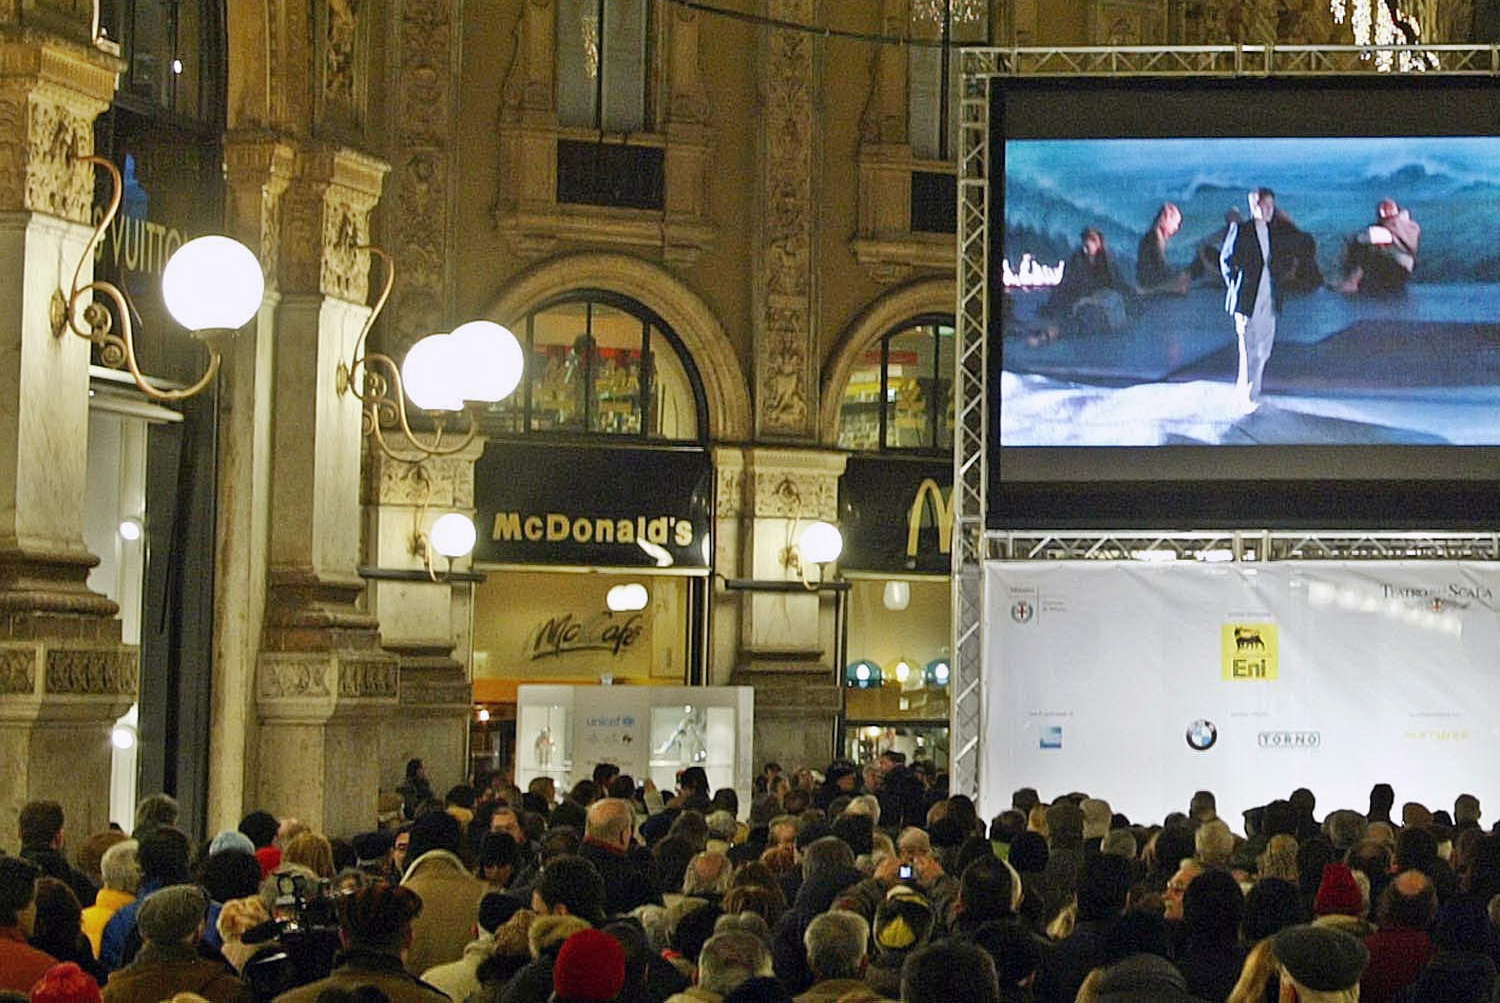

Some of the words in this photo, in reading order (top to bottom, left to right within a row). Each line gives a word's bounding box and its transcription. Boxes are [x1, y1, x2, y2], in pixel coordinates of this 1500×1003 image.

[111, 214, 189, 276] VUITTO
[492, 512, 693, 546] McDonald's
[1233, 659, 1266, 677] Eni
[1263, 734, 1317, 746] TORNO
